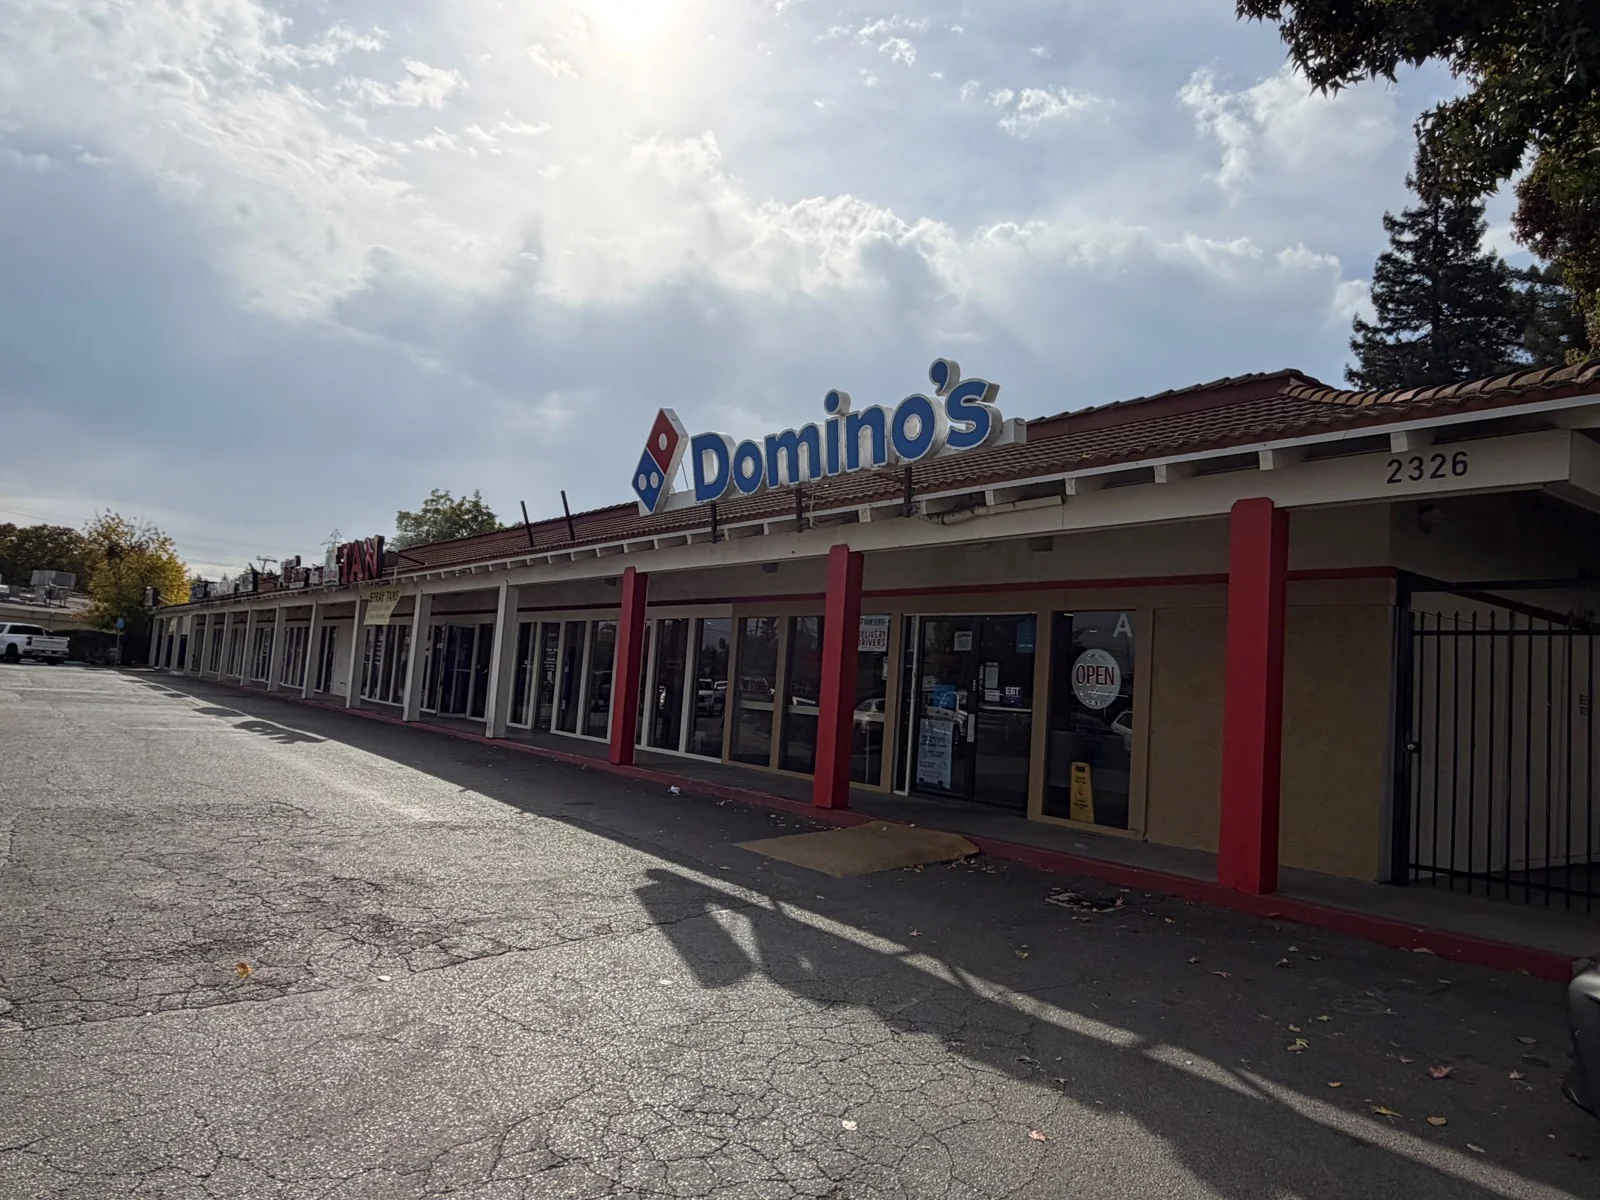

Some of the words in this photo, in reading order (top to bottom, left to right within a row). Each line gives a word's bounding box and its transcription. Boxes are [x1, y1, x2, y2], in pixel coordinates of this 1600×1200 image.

[691, 358, 1000, 503] Domino's
[1387, 451, 1468, 484] 2326
[1112, 613, 1133, 637] A
[1076, 664, 1114, 686] OPEN
[1005, 686, 1021, 695] EBT
